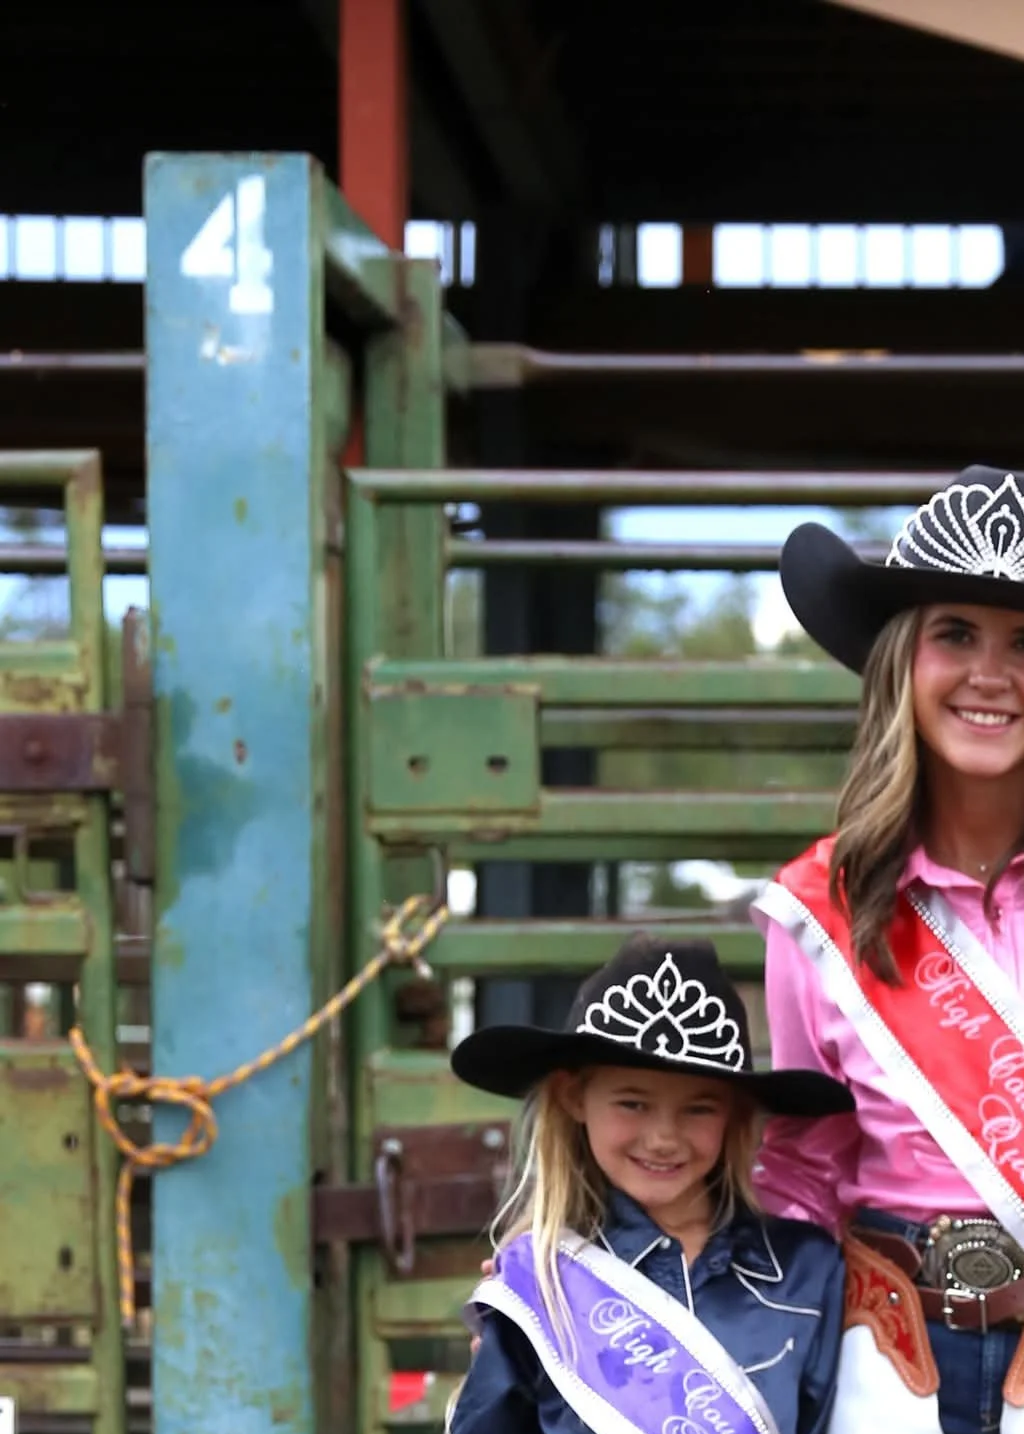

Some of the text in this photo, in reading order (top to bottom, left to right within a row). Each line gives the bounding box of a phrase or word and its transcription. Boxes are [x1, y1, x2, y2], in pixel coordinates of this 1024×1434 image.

[180, 172, 274, 315] 4
[914, 951, 984, 1041] High
[588, 1296, 673, 1375] High
